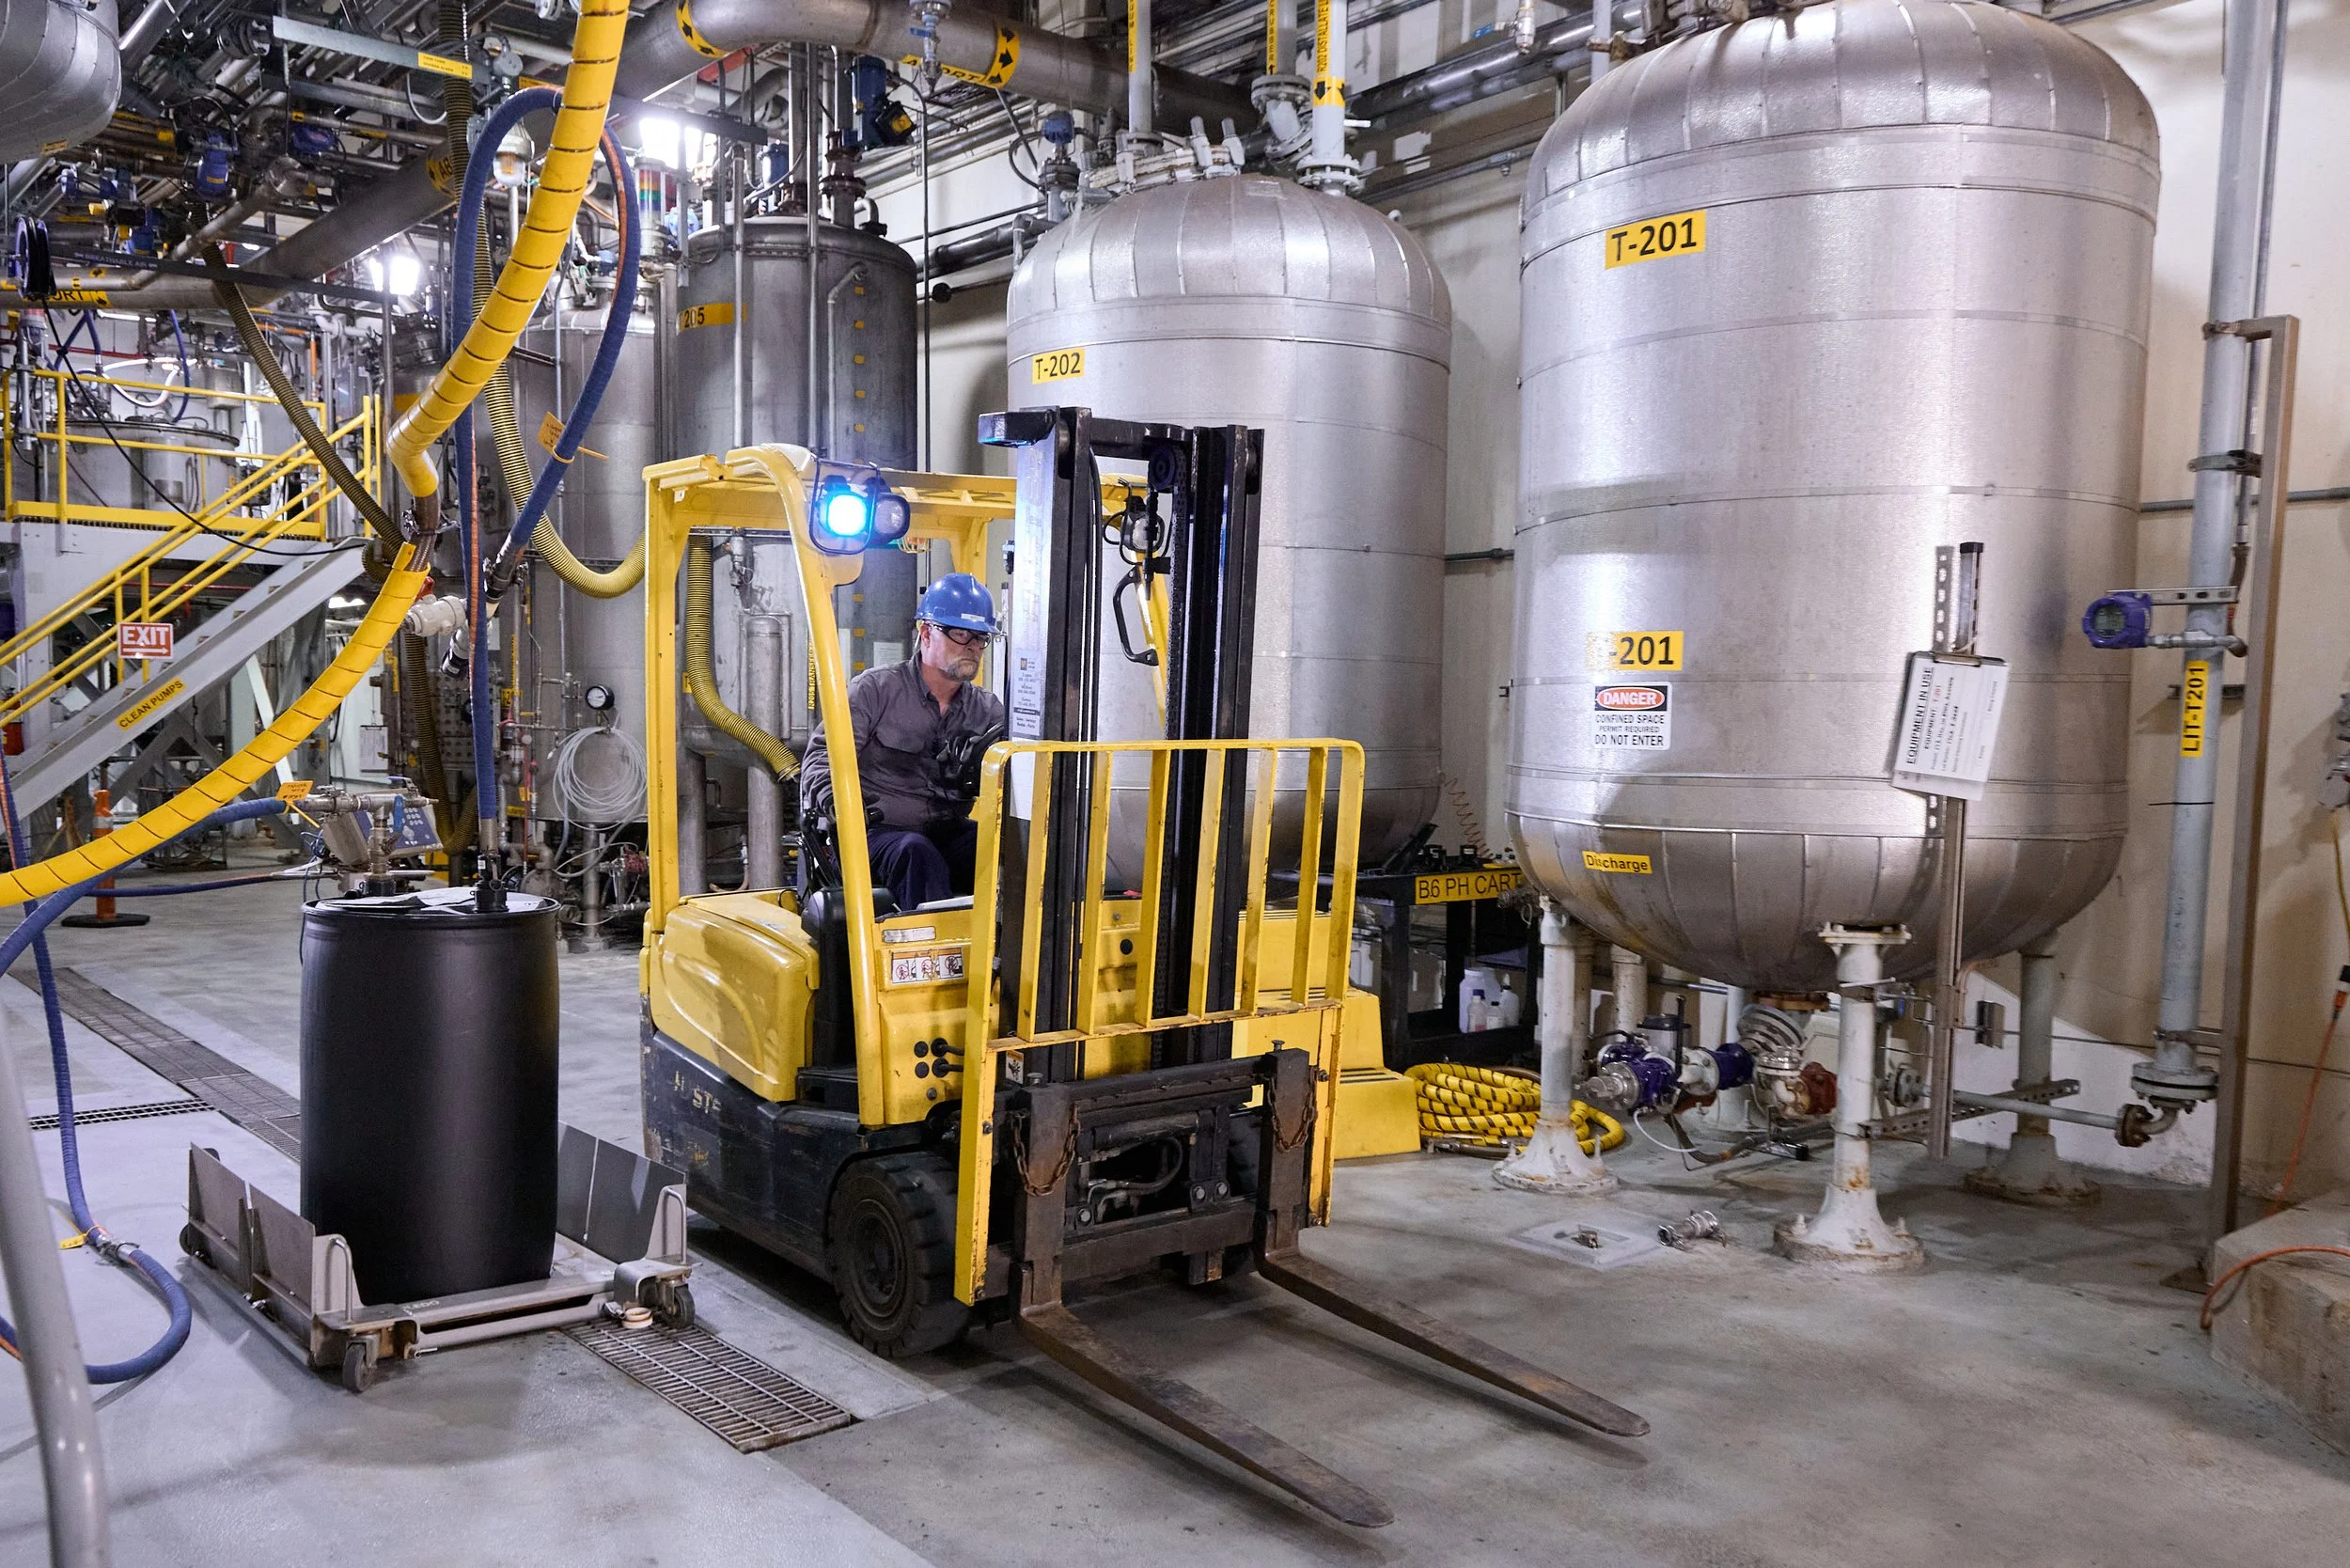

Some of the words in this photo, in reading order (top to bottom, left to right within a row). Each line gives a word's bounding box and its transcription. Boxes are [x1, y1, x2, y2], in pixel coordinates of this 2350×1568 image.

[1611, 217, 1698, 261] T-201
[1035, 353, 1081, 380] T-202
[122, 626, 169, 646] EXIT
[1601, 636, 1674, 666] -201
[1921, 667, 1935, 688] USE
[119, 702, 151, 728] CLEAN
[150, 680, 183, 706] PUMPS
[1603, 692, 1657, 705] DANGER
[1919, 690, 1930, 704] IN
[1596, 714, 1634, 724] CONFINED
[1637, 714, 1665, 724] SPACE
[2184, 667, 2204, 752] LIT-T201
[1594, 734, 1606, 745] DO
[1610, 735, 1628, 745] NOT
[1632, 735, 1664, 746] ENTER
[1906, 705, 1927, 764] EQUIPMENT
[1587, 854, 1649, 872] Discharge
[1446, 875, 1469, 896] PH
[1474, 872, 1522, 894] CART
